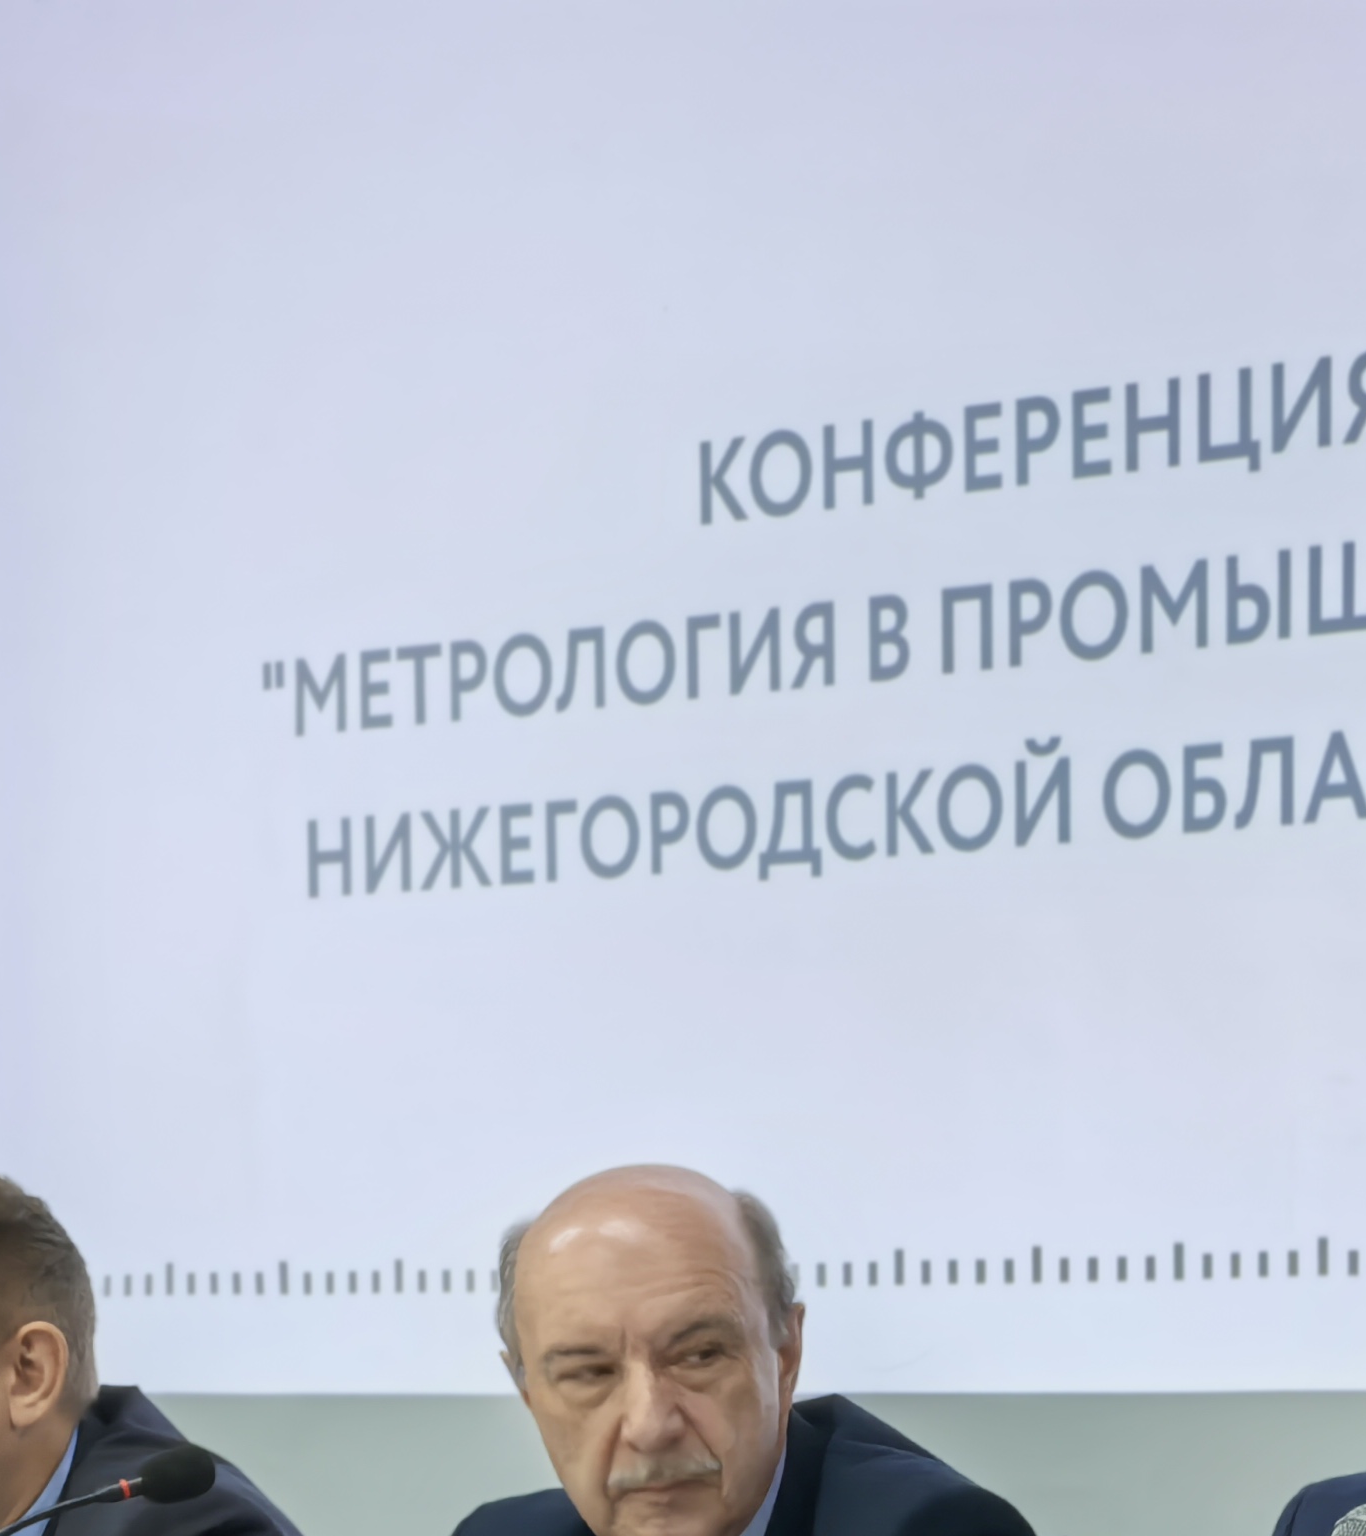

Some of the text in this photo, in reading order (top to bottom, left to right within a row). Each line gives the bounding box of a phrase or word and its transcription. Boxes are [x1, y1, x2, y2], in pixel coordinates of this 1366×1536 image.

[261, 600, 836, 737] "МЕТРОЛОГИЯ
[868, 593, 911, 683] В
[306, 735, 1072, 899] НИЖЕГОРОДСКОЙ
